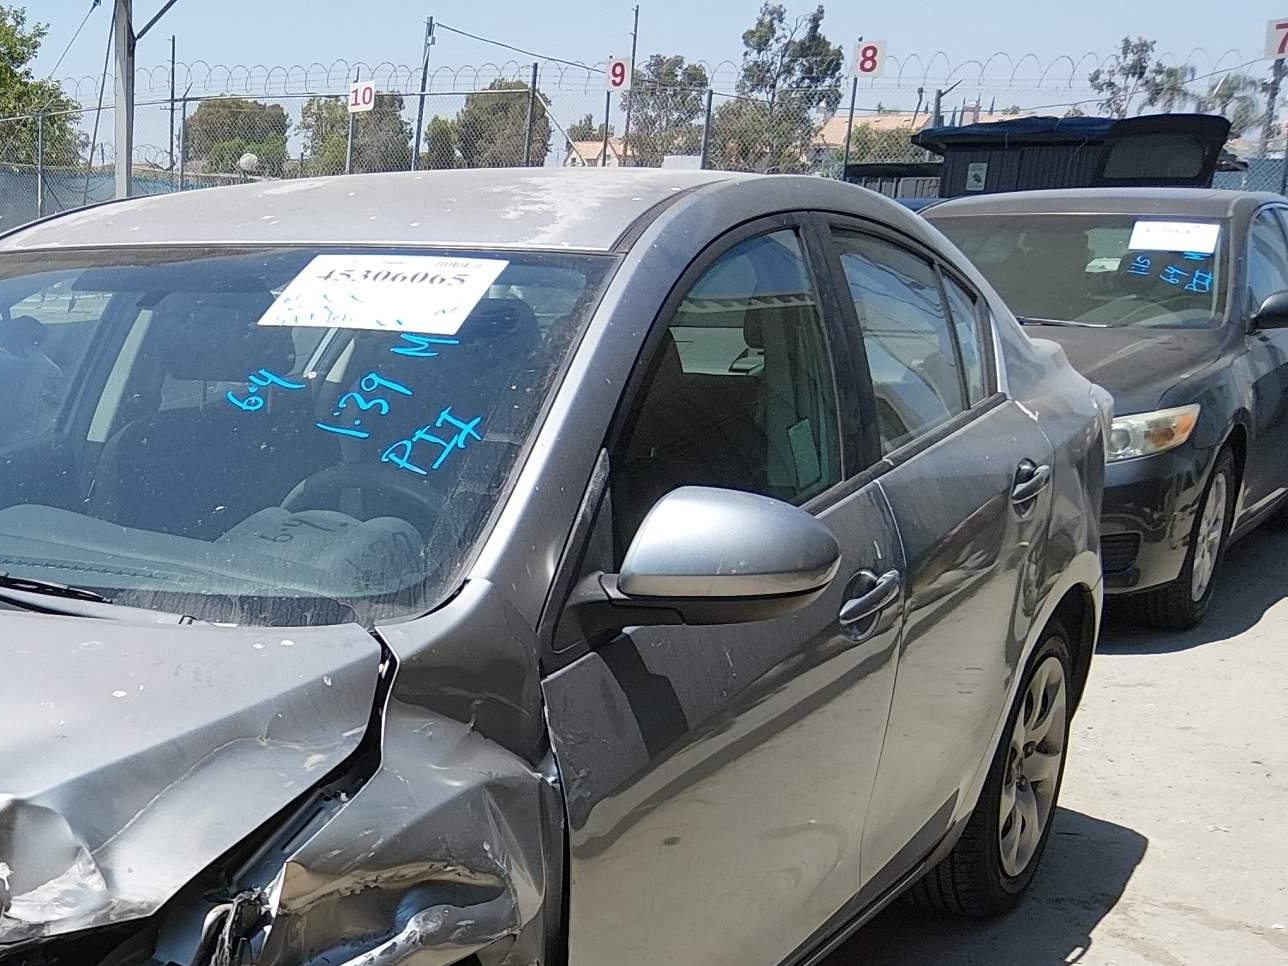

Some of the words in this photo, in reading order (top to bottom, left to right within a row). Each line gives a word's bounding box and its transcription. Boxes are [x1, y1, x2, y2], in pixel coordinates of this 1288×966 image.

[1275, 22, 1288, 54] 7
[859, 45, 878, 73] 8
[611, 62, 626, 87] 9
[350, 86, 373, 107] 10
[316, 268, 470, 287] 45306065
[315, 371, 413, 440] 1:39
